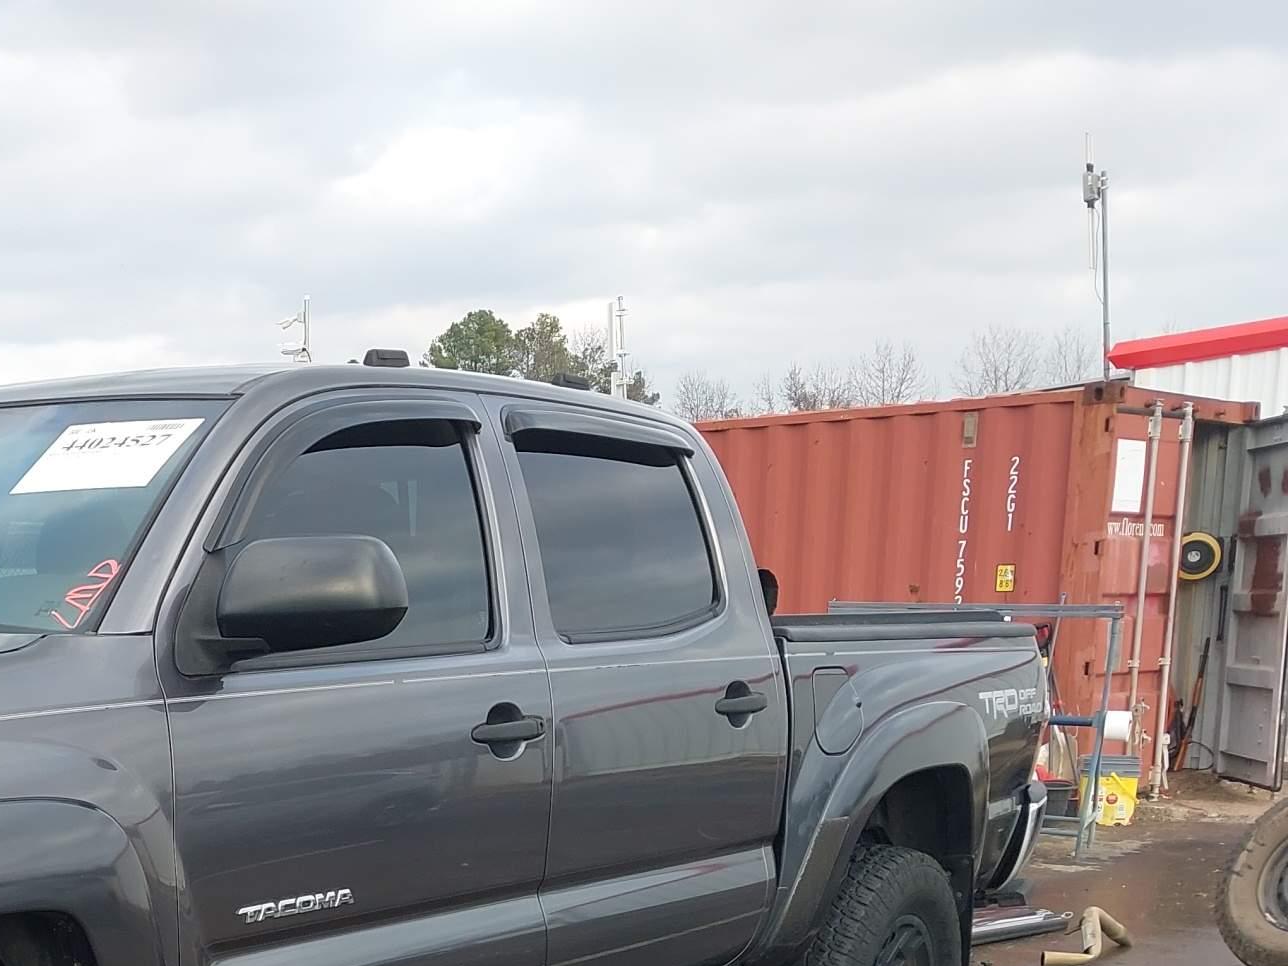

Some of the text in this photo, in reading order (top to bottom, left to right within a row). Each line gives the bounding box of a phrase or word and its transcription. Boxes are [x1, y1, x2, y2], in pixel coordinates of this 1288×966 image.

[62, 434, 173, 452] 44024527
[959, 459, 973, 533] FSCU
[1006, 456, 1020, 532] 22G1
[978, 688, 1037, 720] TRD OFF
[238, 888, 355, 924] TACOMA
